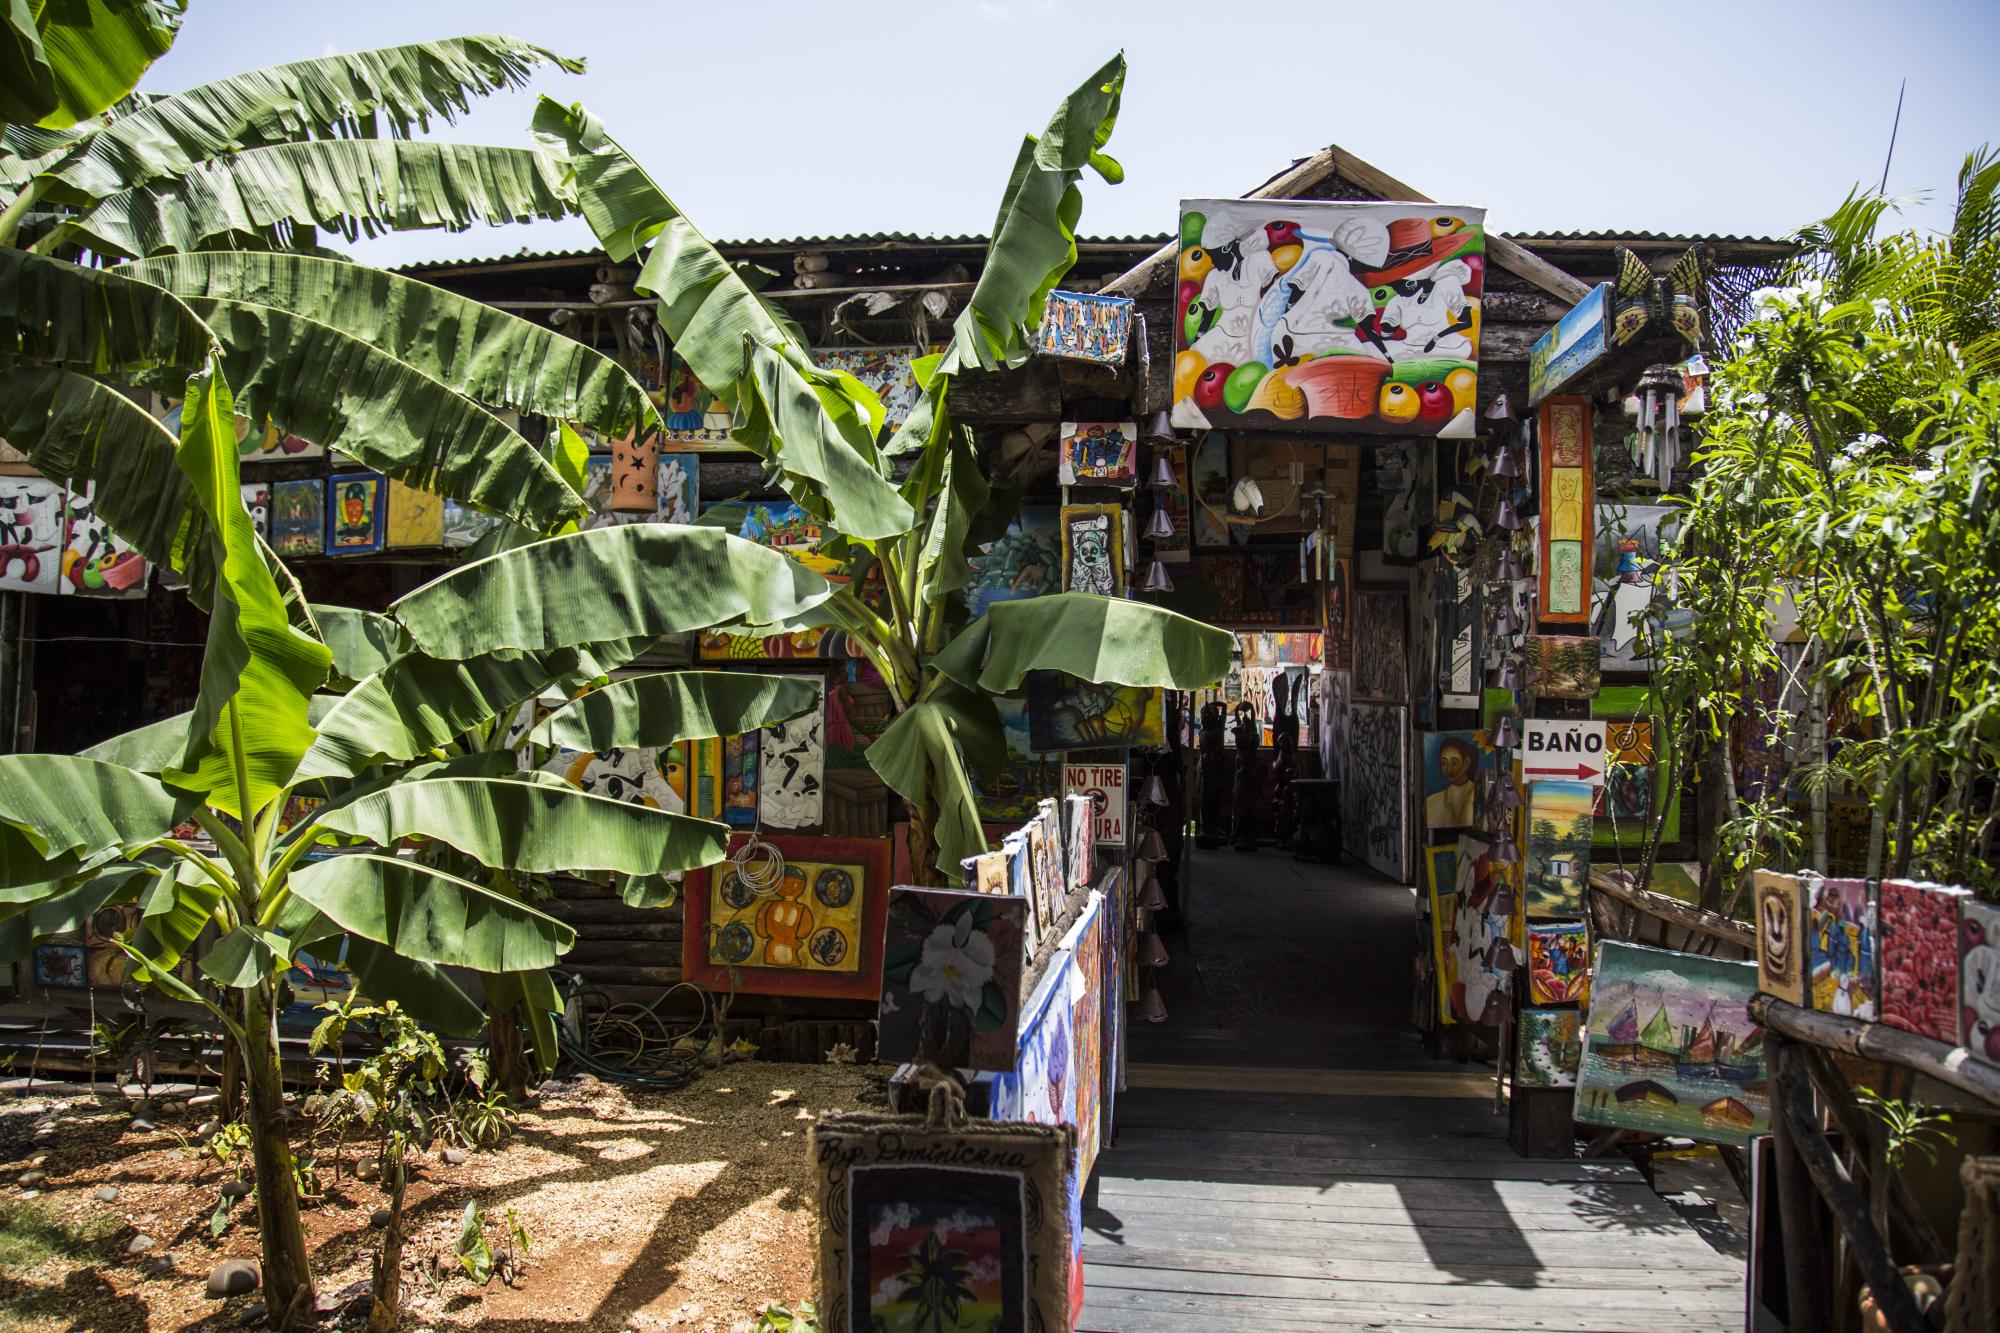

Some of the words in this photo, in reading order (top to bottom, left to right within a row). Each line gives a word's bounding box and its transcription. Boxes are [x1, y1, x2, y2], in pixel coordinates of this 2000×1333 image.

[1528, 728, 1602, 753] BAÑO
[1067, 768, 1087, 787] NO
[1091, 768, 1122, 787] TIRE
[1094, 818, 1121, 840] URA
[876, 1132, 1036, 1169] Dominicana
